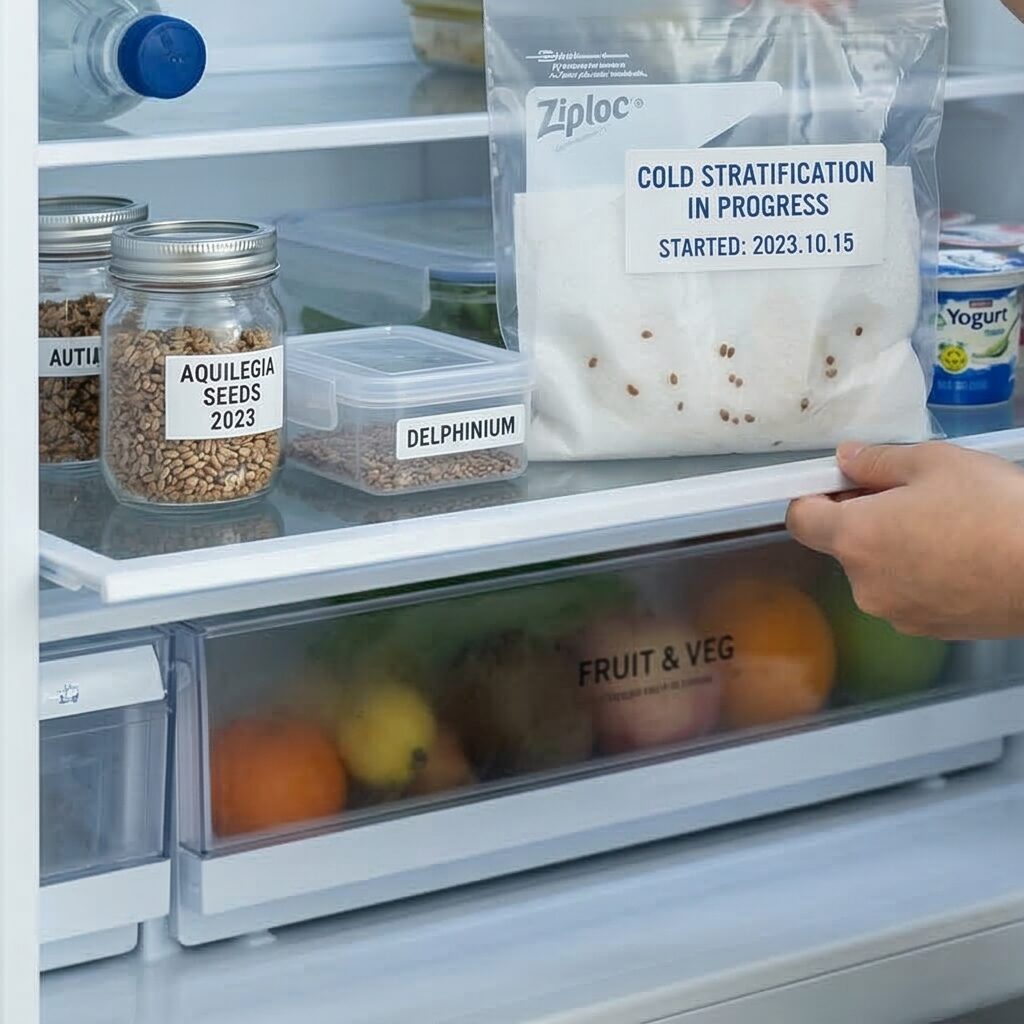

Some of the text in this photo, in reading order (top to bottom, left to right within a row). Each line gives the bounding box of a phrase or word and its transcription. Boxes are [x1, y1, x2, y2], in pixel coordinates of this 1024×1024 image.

[637, 160, 875, 189] COLD STRATIFICATION
[688, 193, 829, 219] IN PROGRESS
[659, 233, 854, 258] STARTED: 2023.10.15
[946, 307, 1008, 330] Yogurt
[180, 356, 275, 384] AQUILEGIA
[203, 383, 261, 406] SEEDS
[211, 408, 256, 431] 2023
[407, 415, 515, 448] DELPHINIUM
[578, 634, 735, 687] FRUIT & VEG
